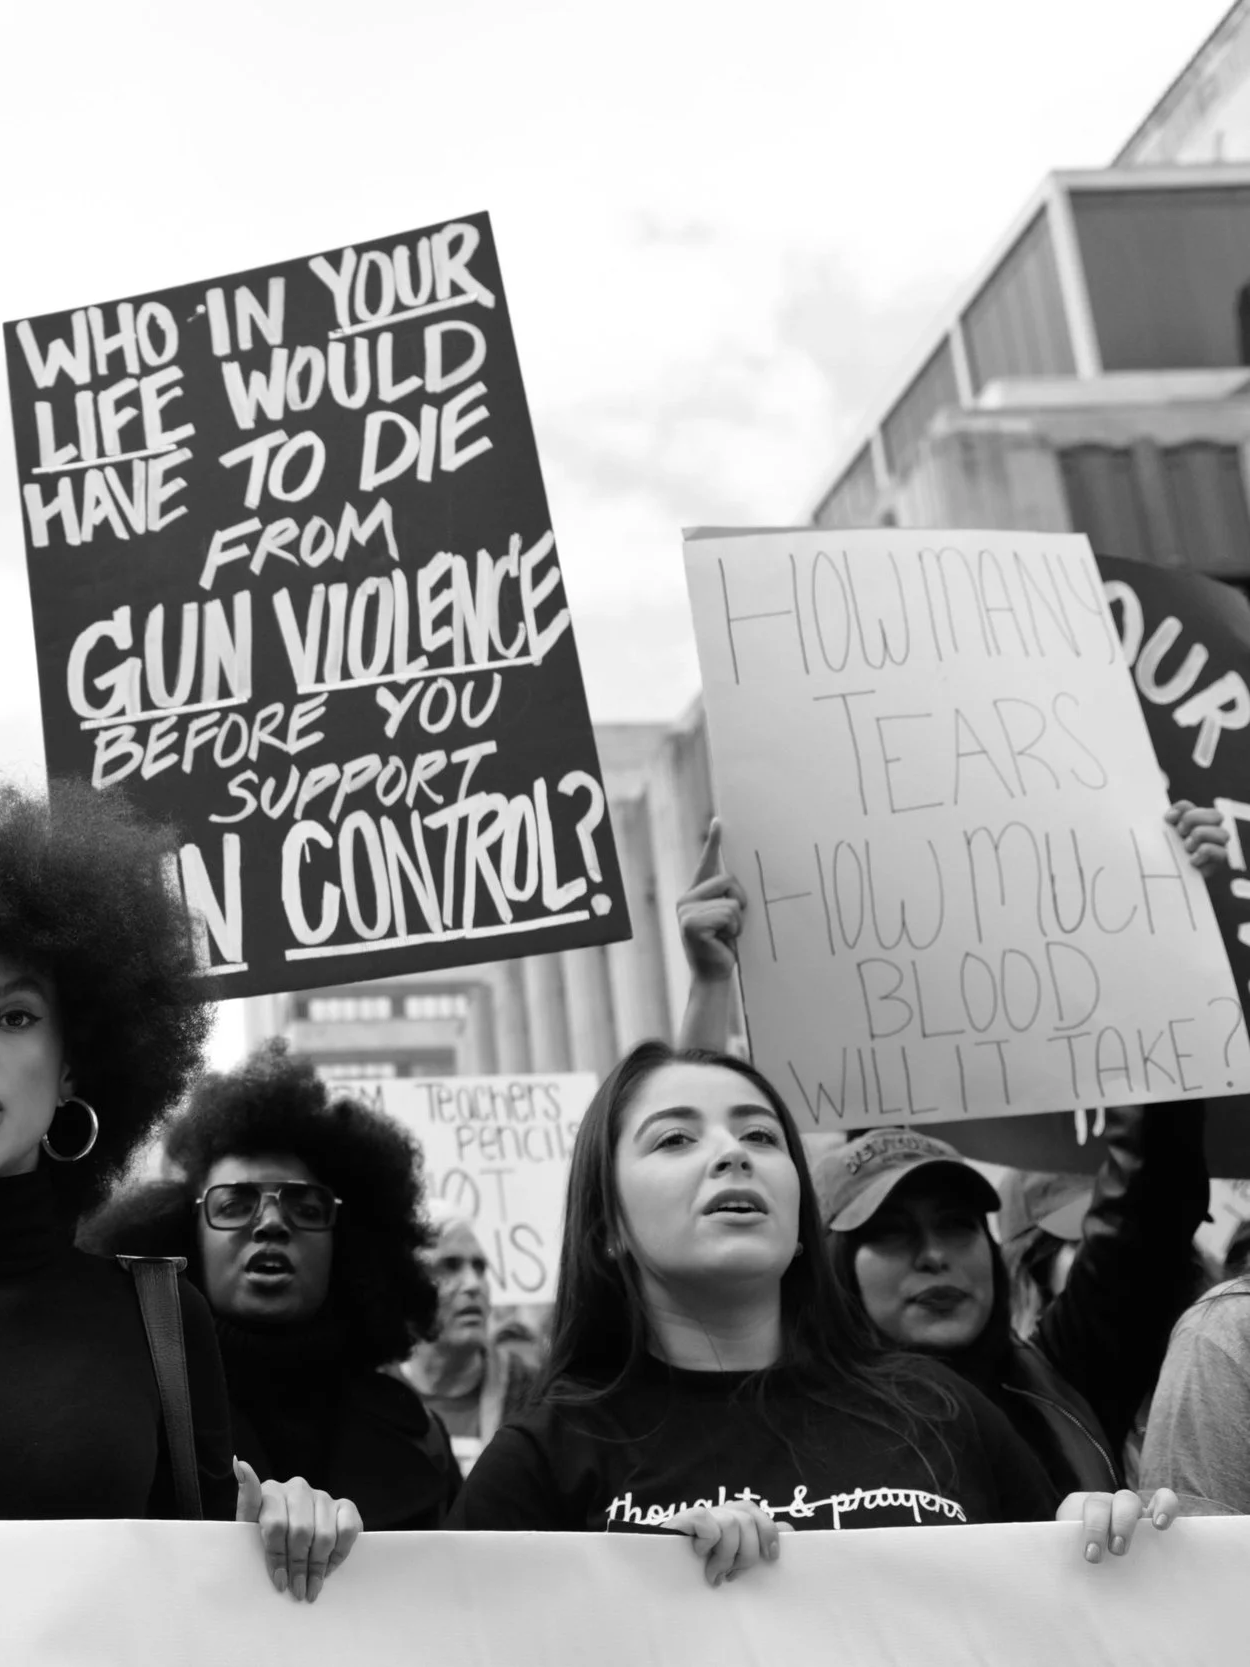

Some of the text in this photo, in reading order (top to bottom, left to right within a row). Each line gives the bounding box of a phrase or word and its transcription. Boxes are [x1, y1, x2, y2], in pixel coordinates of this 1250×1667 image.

[16, 223, 495, 388] WHO IN YOUR
[35, 320, 488, 466] LIFE WOULD
[23, 382, 494, 548] HAVE TO DIE
[199, 498, 400, 589] FROM
[66, 530, 572, 718] GUN VIOLENCE
[92, 673, 502, 790] BEFORE YOU
[209, 742, 498, 823] SUPPORT
[812, 690, 1107, 816] TEARS
[281, 771, 612, 950] CONTROL?
[755, 838, 945, 963] HOW
[963, 821, 1197, 943] MUCH
[856, 941, 1101, 1041] BLOOD
[787, 996, 1243, 1125] WILL IT TAKE?
[426, 1166, 516, 1222] OT
